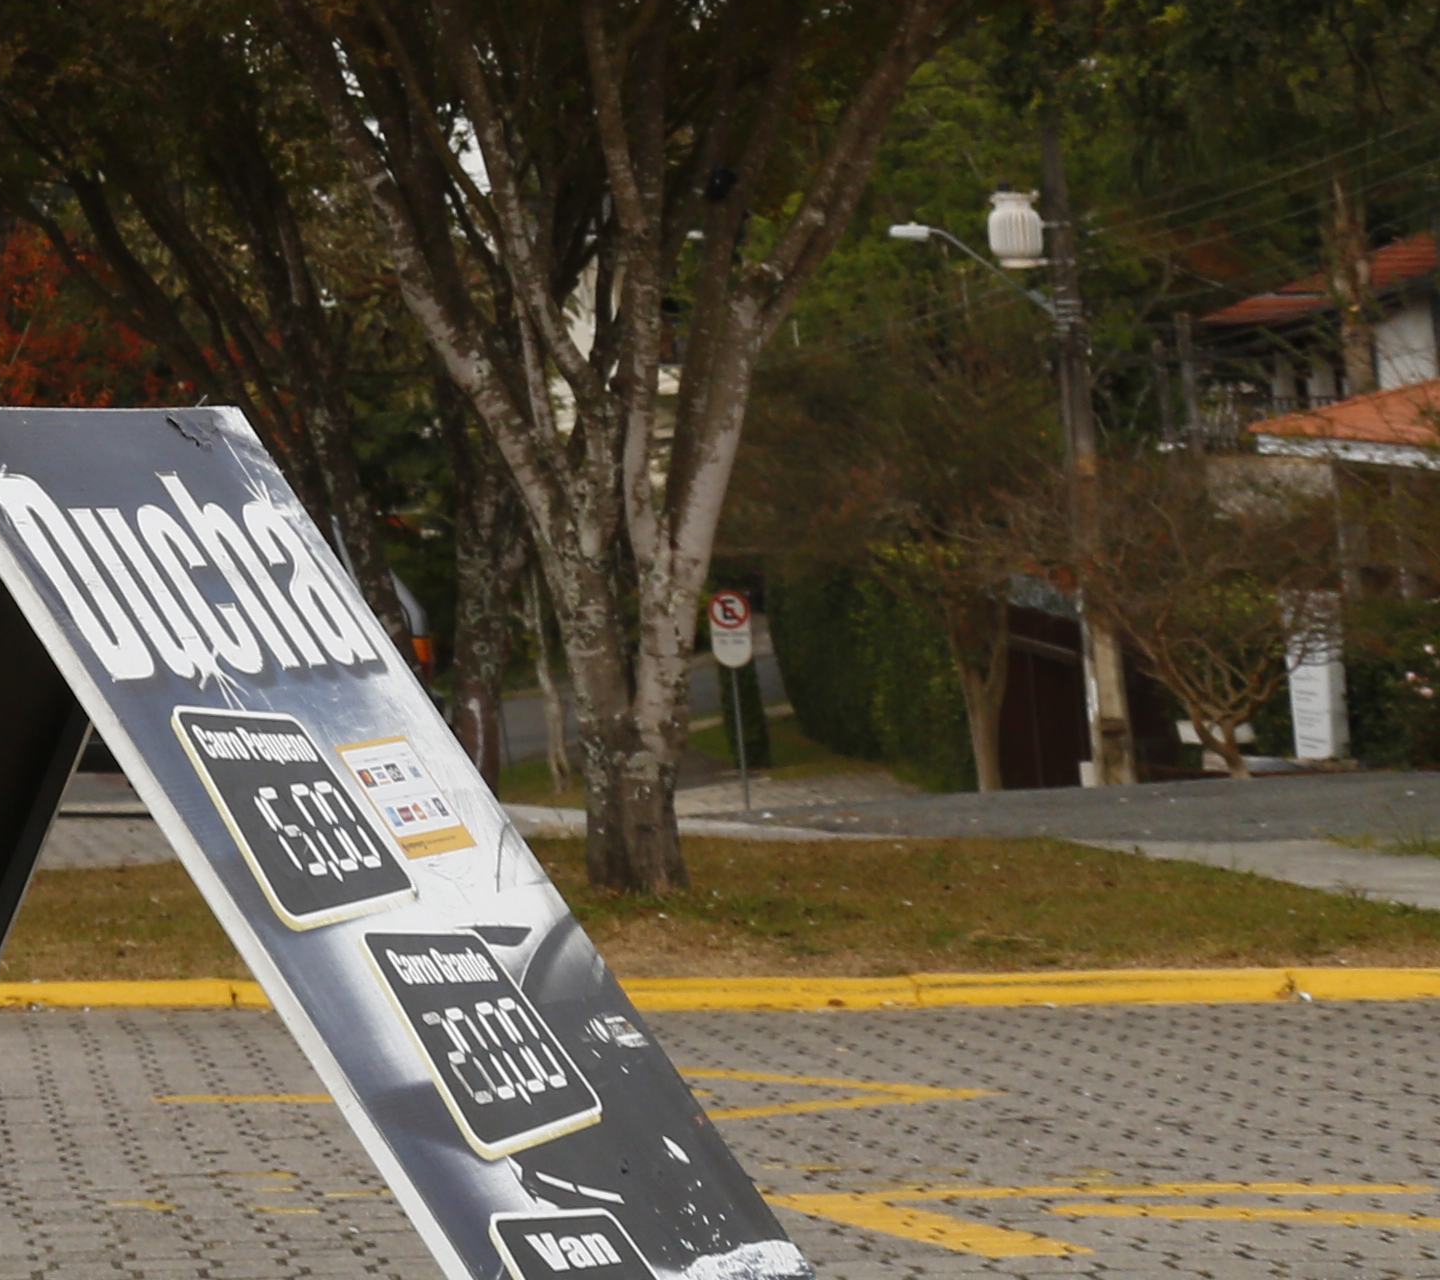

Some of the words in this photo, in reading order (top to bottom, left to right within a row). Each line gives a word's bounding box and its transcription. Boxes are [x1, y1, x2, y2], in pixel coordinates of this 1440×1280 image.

[191, 724, 255, 761] Carro
[240, 725, 318, 765] Pequeno
[386, 949, 445, 985] Carro
[429, 947, 499, 984] Grande
[421, 996, 568, 1105] 20,00
[524, 1230, 623, 1272] Van
